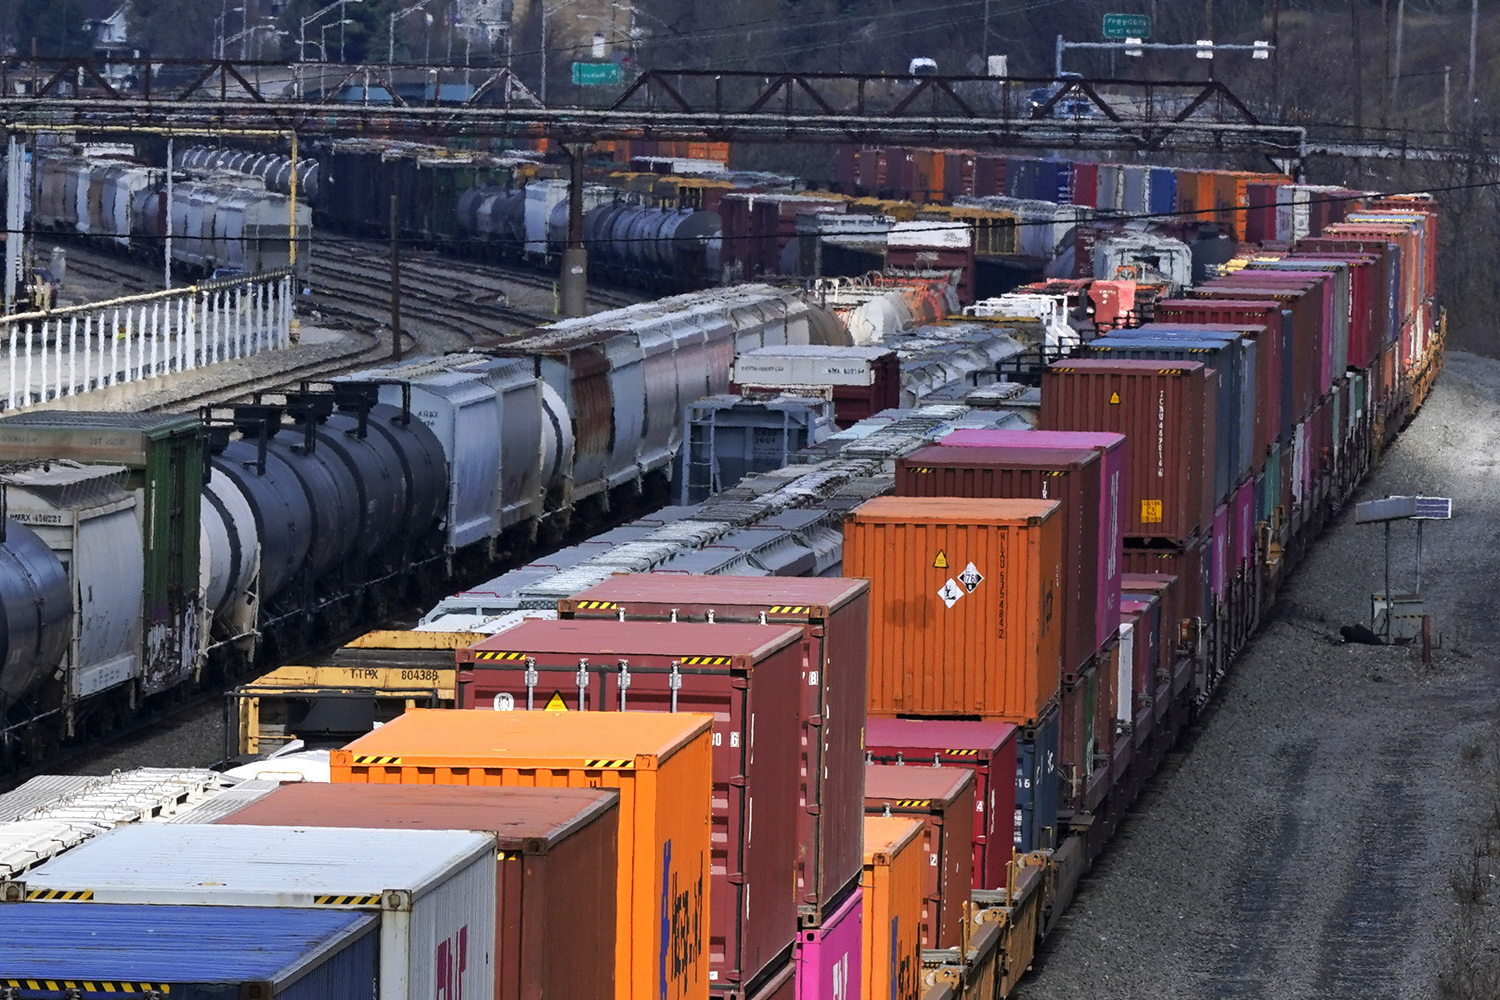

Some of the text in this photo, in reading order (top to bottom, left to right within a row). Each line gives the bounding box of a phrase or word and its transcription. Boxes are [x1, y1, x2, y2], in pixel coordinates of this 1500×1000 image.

[350, 668, 438, 681] TTPX 804389
[810, 672, 818, 684] 8
[731, 732, 739, 747] 6
